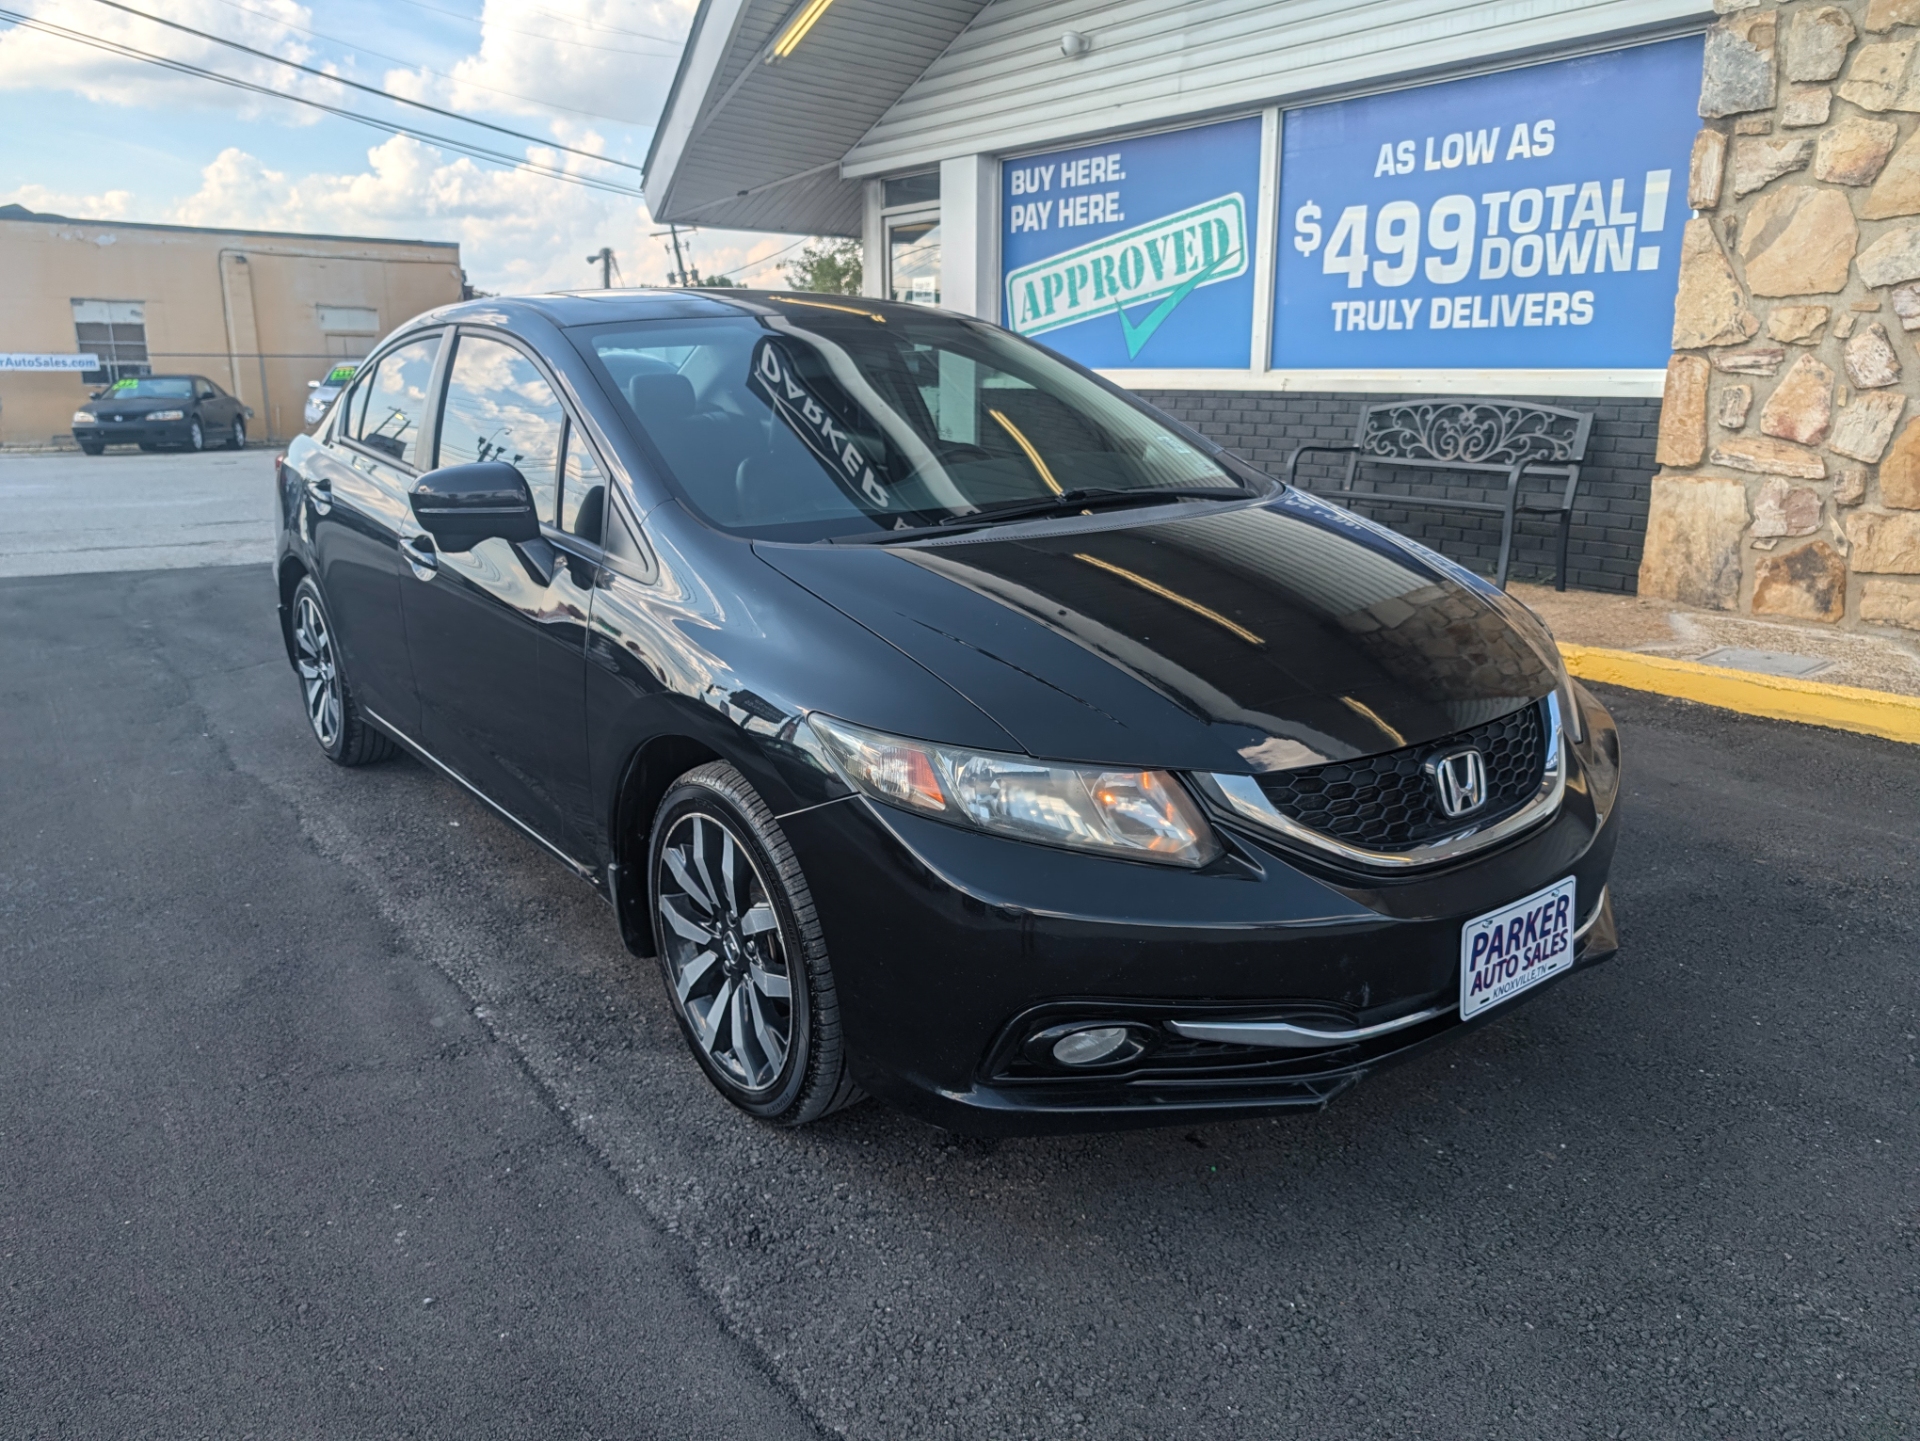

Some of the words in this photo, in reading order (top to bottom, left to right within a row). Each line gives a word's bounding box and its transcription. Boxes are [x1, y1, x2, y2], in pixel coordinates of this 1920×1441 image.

[1011, 165, 1055, 195] BUY
[1060, 153, 1126, 188] HERE.
[1374, 140, 1415, 178] AS
[1424, 127, 1500, 172] LOW
[1506, 119, 1556, 161] AS
[1011, 200, 1053, 233] PAY
[1058, 191, 1125, 228] HERE.
[1481, 178, 1637, 236] TOTAL
[1019, 217, 1231, 324] APPROVED
[1293, 195, 1477, 289] $499
[1331, 298, 1423, 332] TRULY
[1429, 291, 1595, 330] DELIVERS
[1469, 894, 1570, 973] PARKER
[1469, 954, 1519, 997] AUTO
[1522, 928, 1569, 971] SALES
